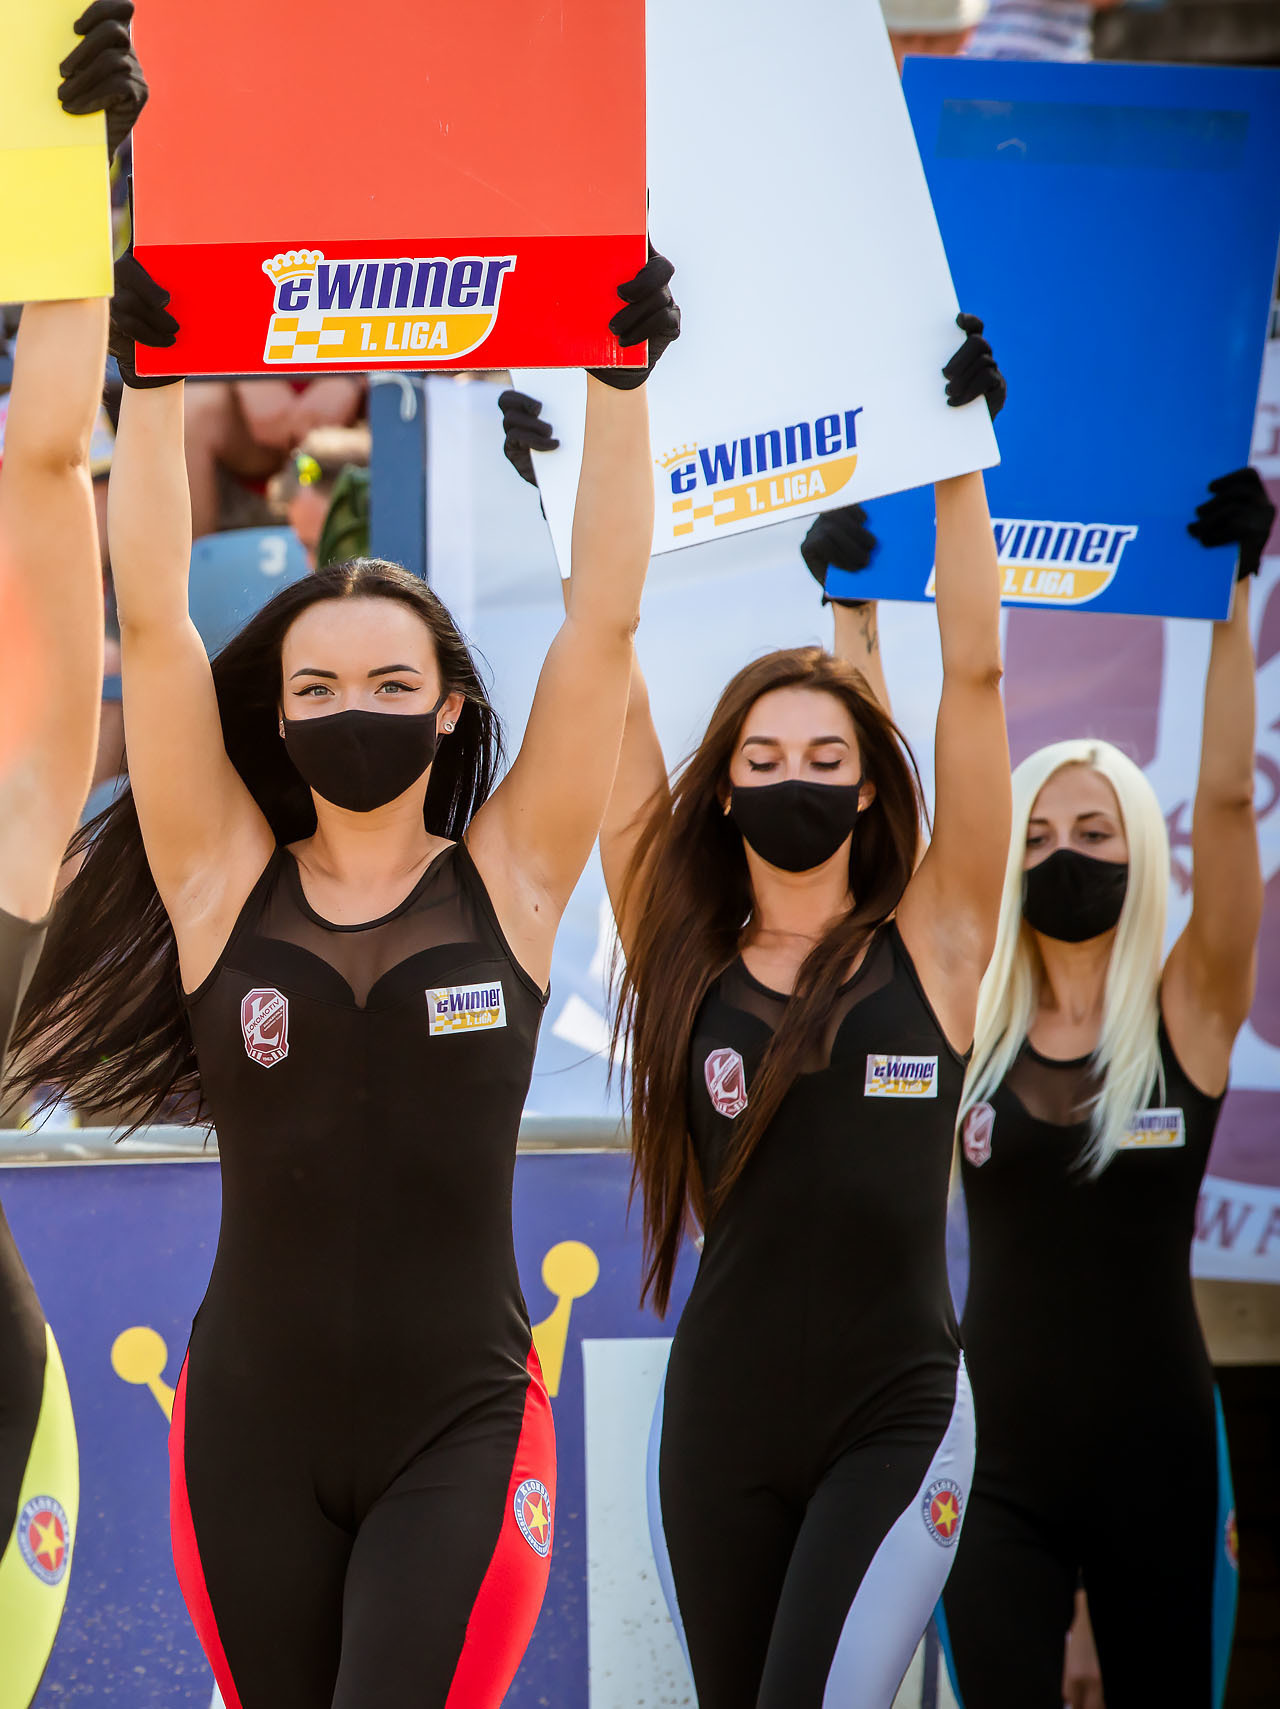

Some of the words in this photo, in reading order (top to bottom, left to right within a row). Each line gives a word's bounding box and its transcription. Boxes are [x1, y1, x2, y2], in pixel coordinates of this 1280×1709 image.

[360, 322, 377, 351] 1.
[384, 320, 449, 350] LIGA
[746, 486, 766, 513] 1.
[769, 469, 827, 507] LIGA
[258, 536, 288, 577] 3
[1002, 568, 1018, 594] 1.
[1022, 569, 1076, 597] LIGA
[246, 998, 281, 1034] LOKOMOTIV
